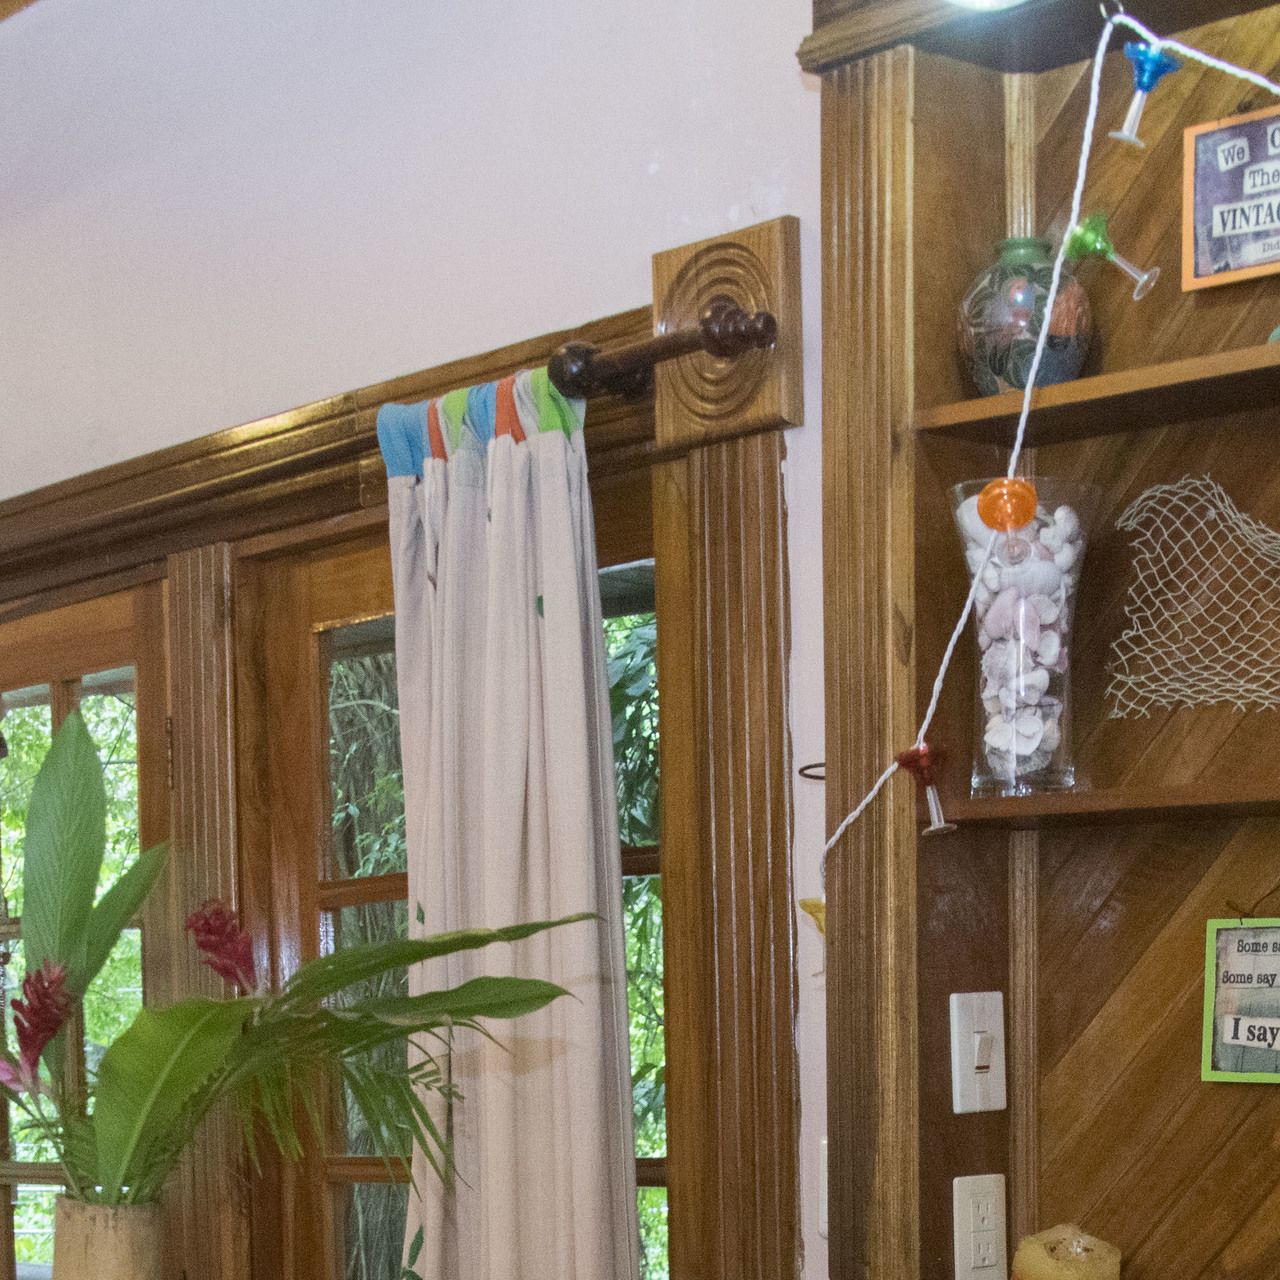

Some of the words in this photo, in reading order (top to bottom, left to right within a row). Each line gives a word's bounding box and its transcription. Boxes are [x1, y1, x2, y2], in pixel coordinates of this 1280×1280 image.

[1221, 144, 1245, 166] We
[1248, 168, 1280, 188] The
[1262, 241, 1280, 253] Did
[1237, 938, 1268, 953] Some
[1222, 970, 1253, 984] Some
[1257, 973, 1277, 987] say
[1231, 1017, 1241, 1040] I
[1246, 1023, 1280, 1048] say
